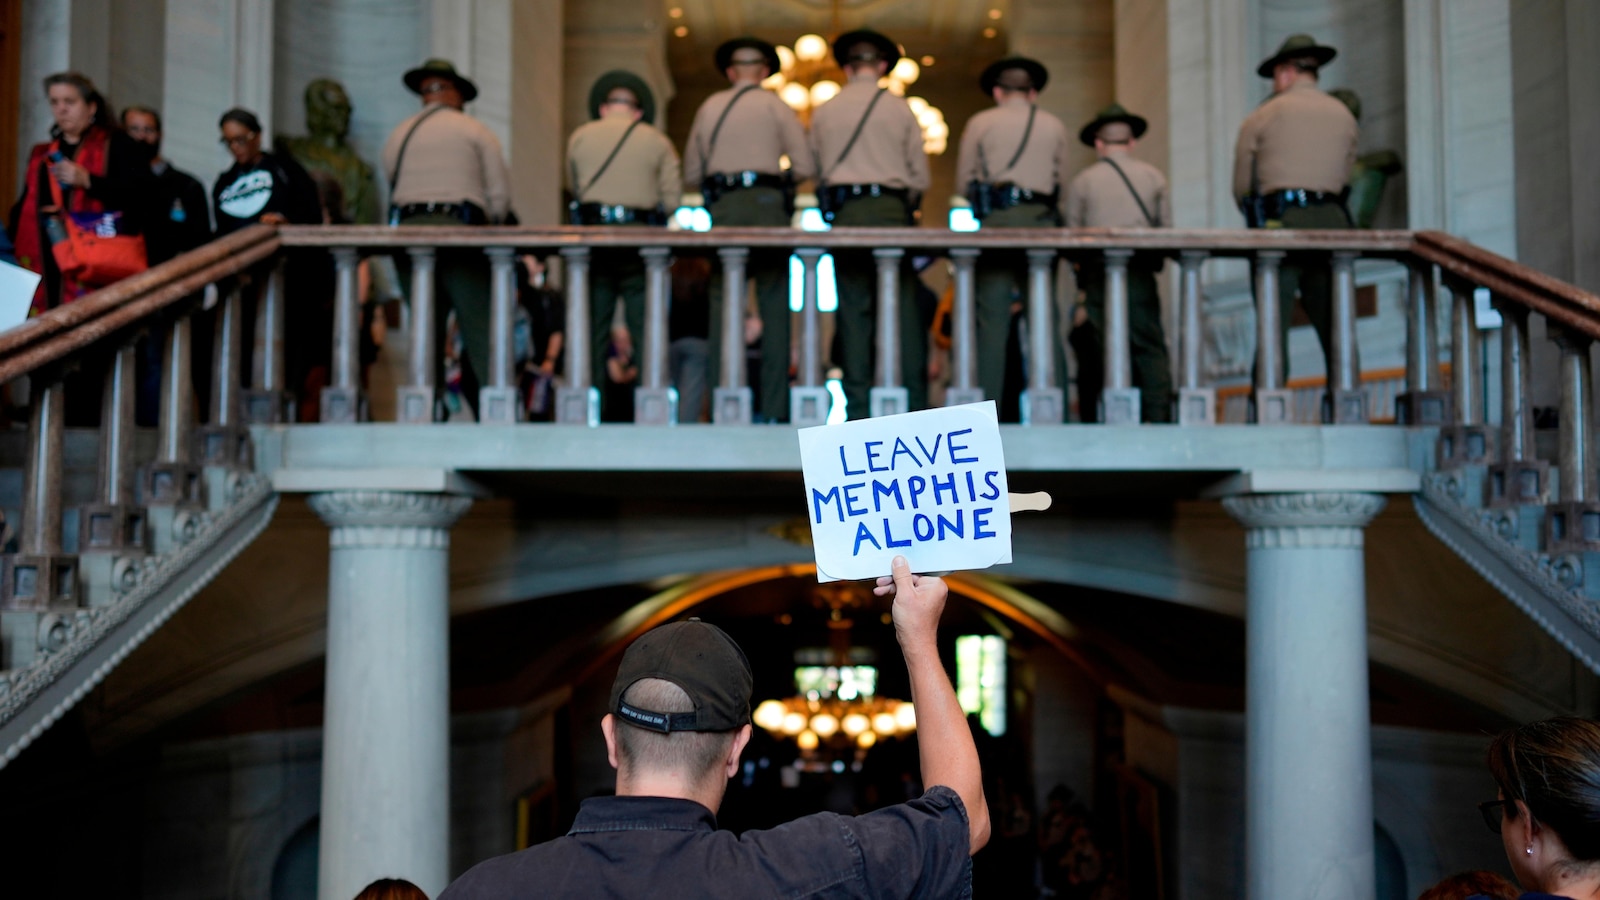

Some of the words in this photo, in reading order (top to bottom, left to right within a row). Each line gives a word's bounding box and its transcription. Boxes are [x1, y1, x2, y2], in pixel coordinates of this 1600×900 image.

[839, 428, 978, 476] LEAVE
[812, 471, 1000, 524] MEMPHIS
[853, 507, 996, 556] ALONE
[642, 714, 653, 723] RACE
